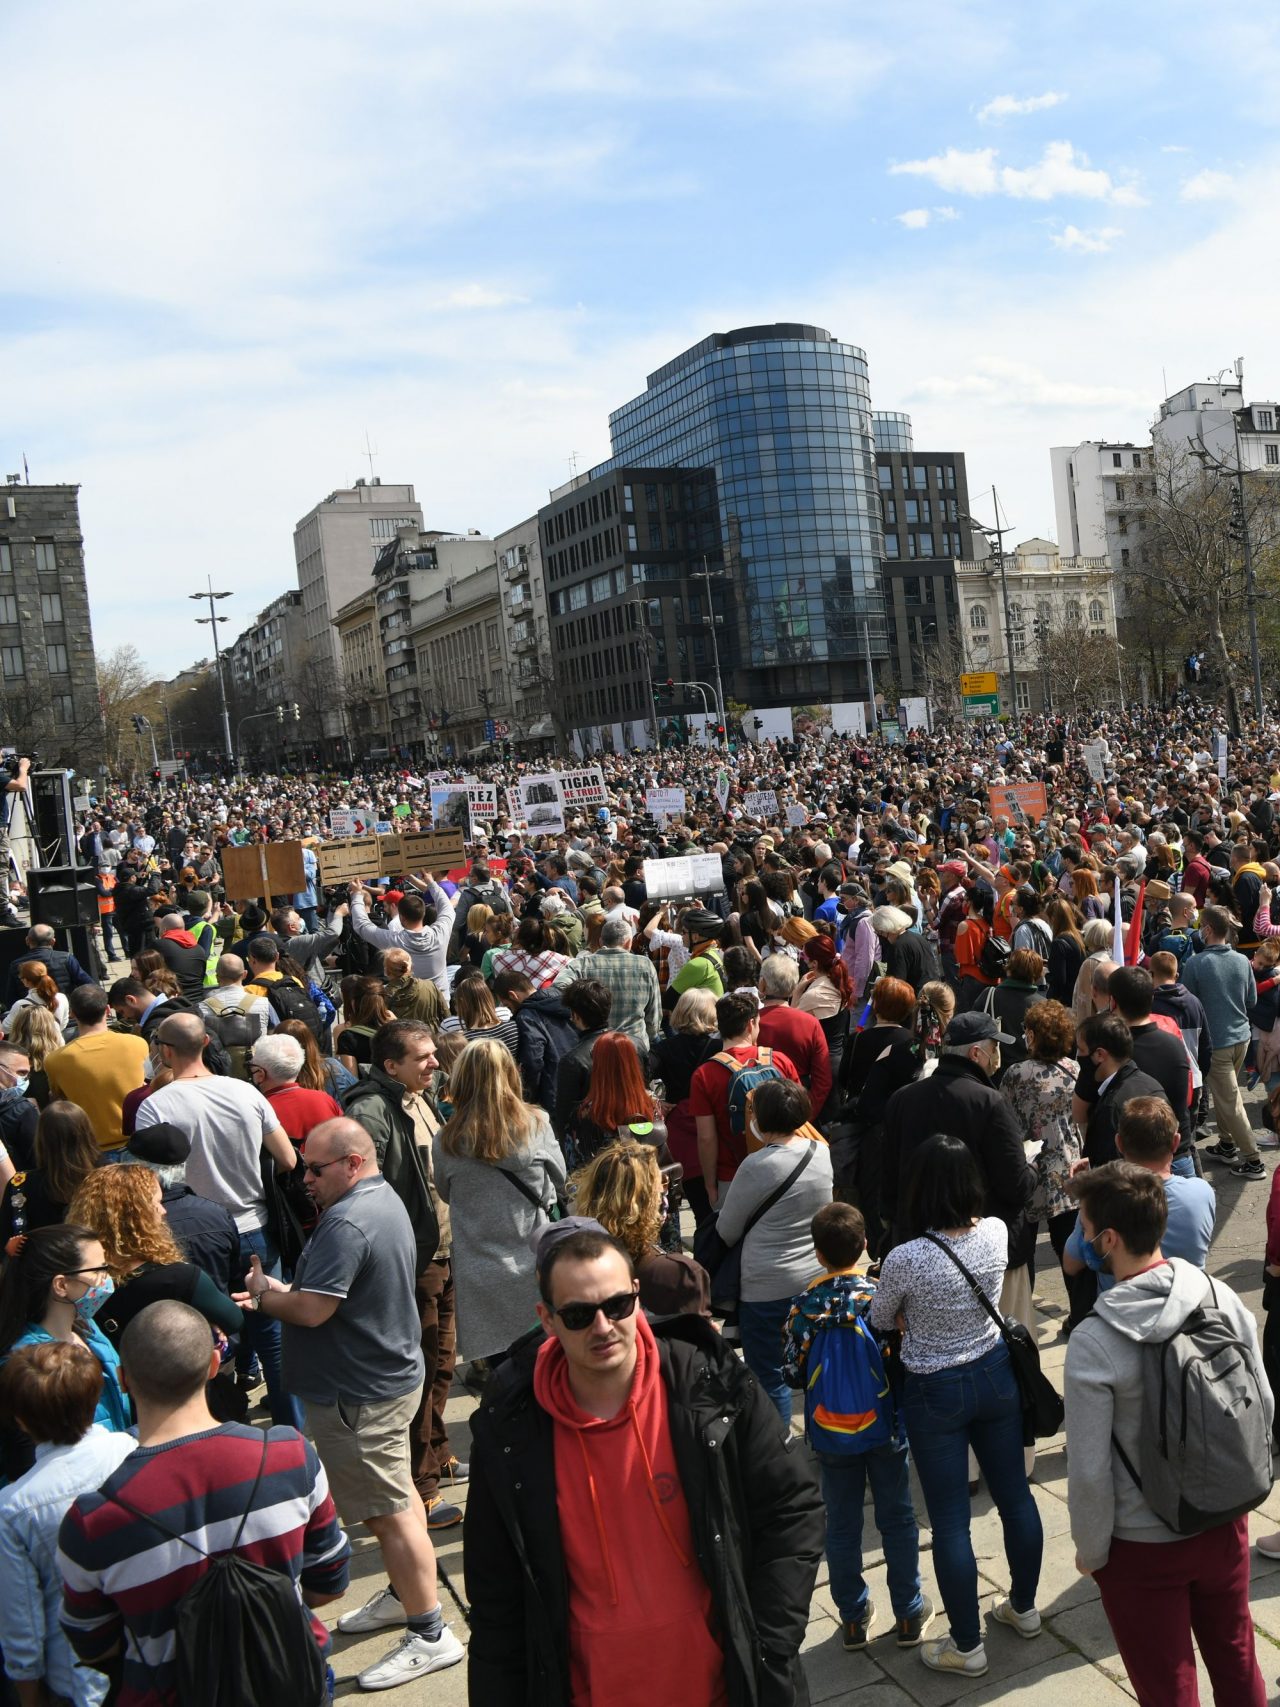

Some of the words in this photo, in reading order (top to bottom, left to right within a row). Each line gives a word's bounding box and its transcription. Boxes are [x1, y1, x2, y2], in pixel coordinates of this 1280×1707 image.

[559, 775, 600, 789] TIGAR
[563, 790, 574, 799] NE
[576, 786, 602, 797] TRUJE
[471, 803, 494, 811] ZDUH
